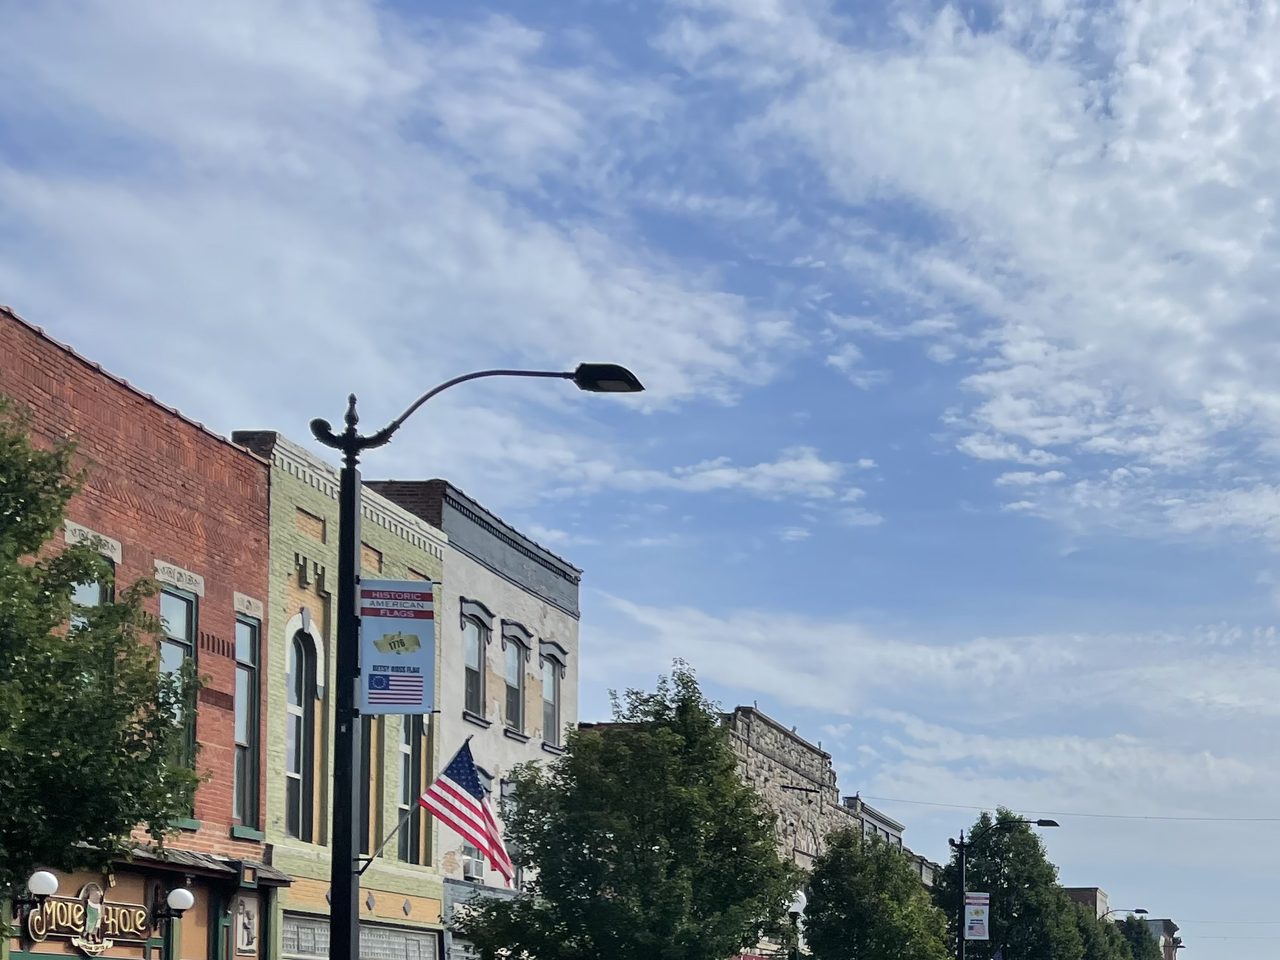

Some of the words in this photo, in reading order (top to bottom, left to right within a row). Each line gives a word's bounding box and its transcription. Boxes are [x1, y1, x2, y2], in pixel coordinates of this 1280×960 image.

[372, 591, 422, 601] HISTORIC
[369, 600, 424, 609] AMERICAN
[379, 610, 415, 618] FLAGS
